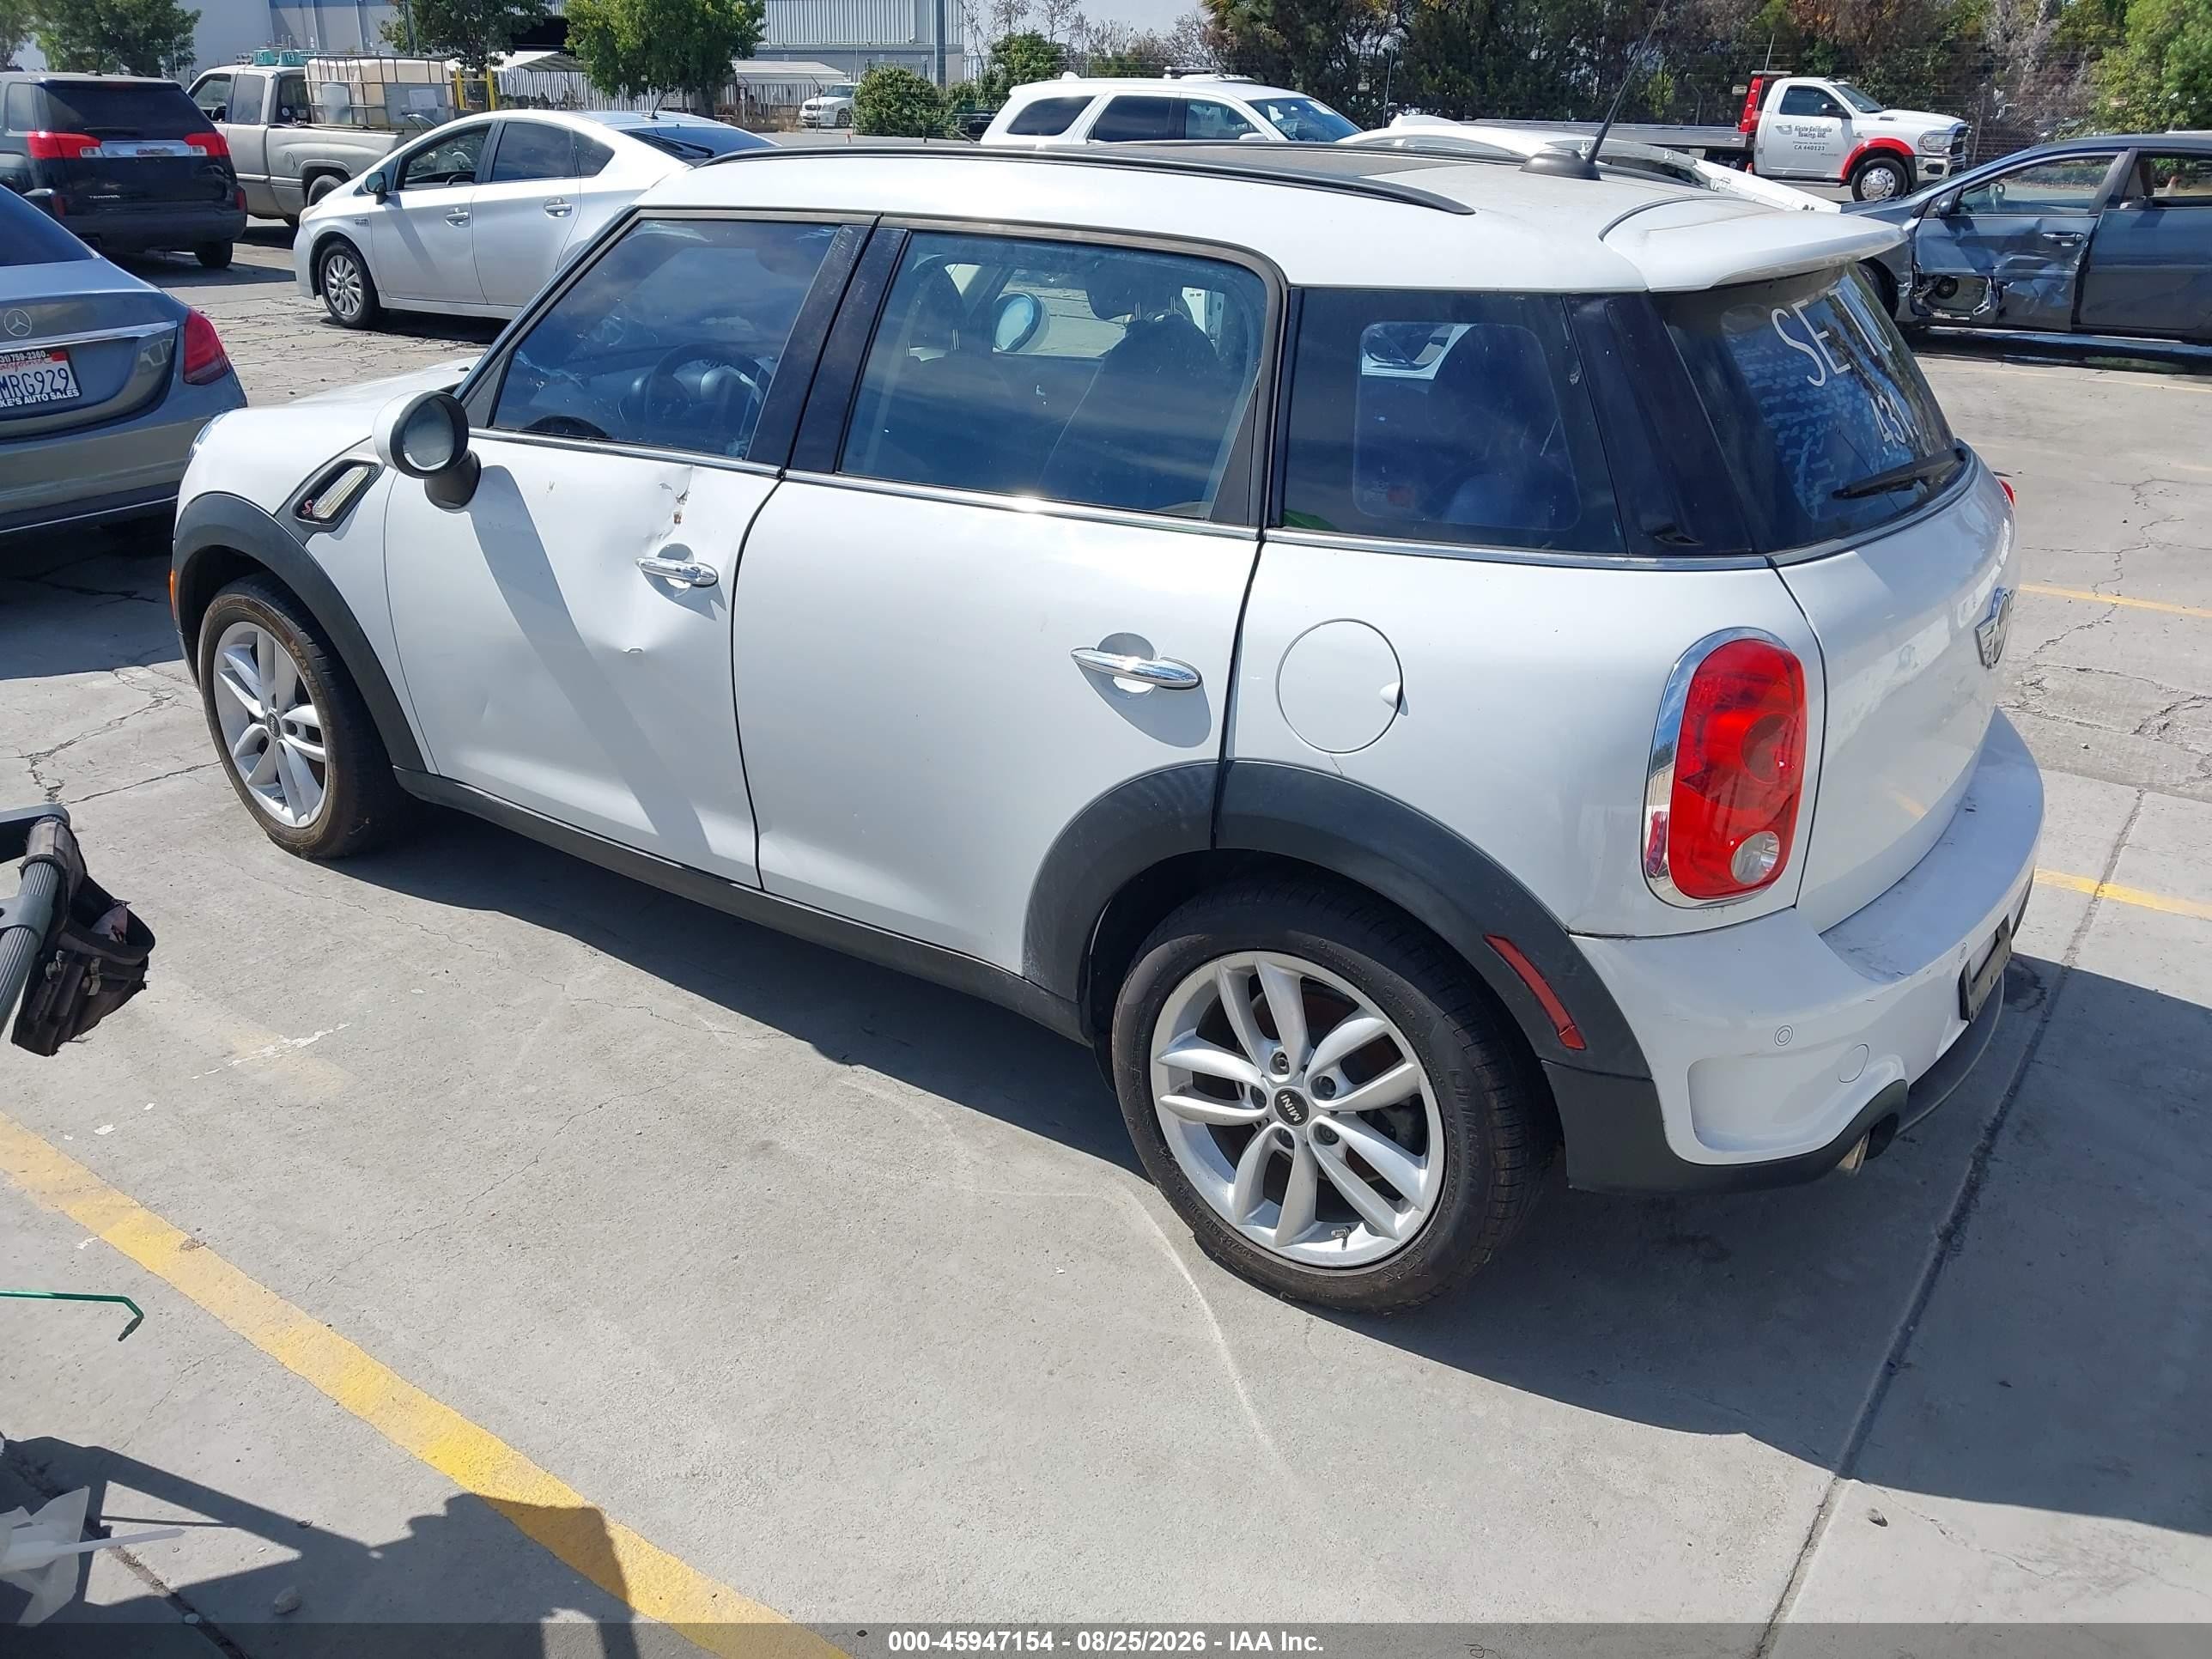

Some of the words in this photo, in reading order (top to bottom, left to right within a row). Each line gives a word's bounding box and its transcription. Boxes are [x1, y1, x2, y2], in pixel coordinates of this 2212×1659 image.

[24, 392, 49, 404] AUTO
[50, 388, 80, 400] SALES
[1280, 1094, 1303, 1122] MINI
